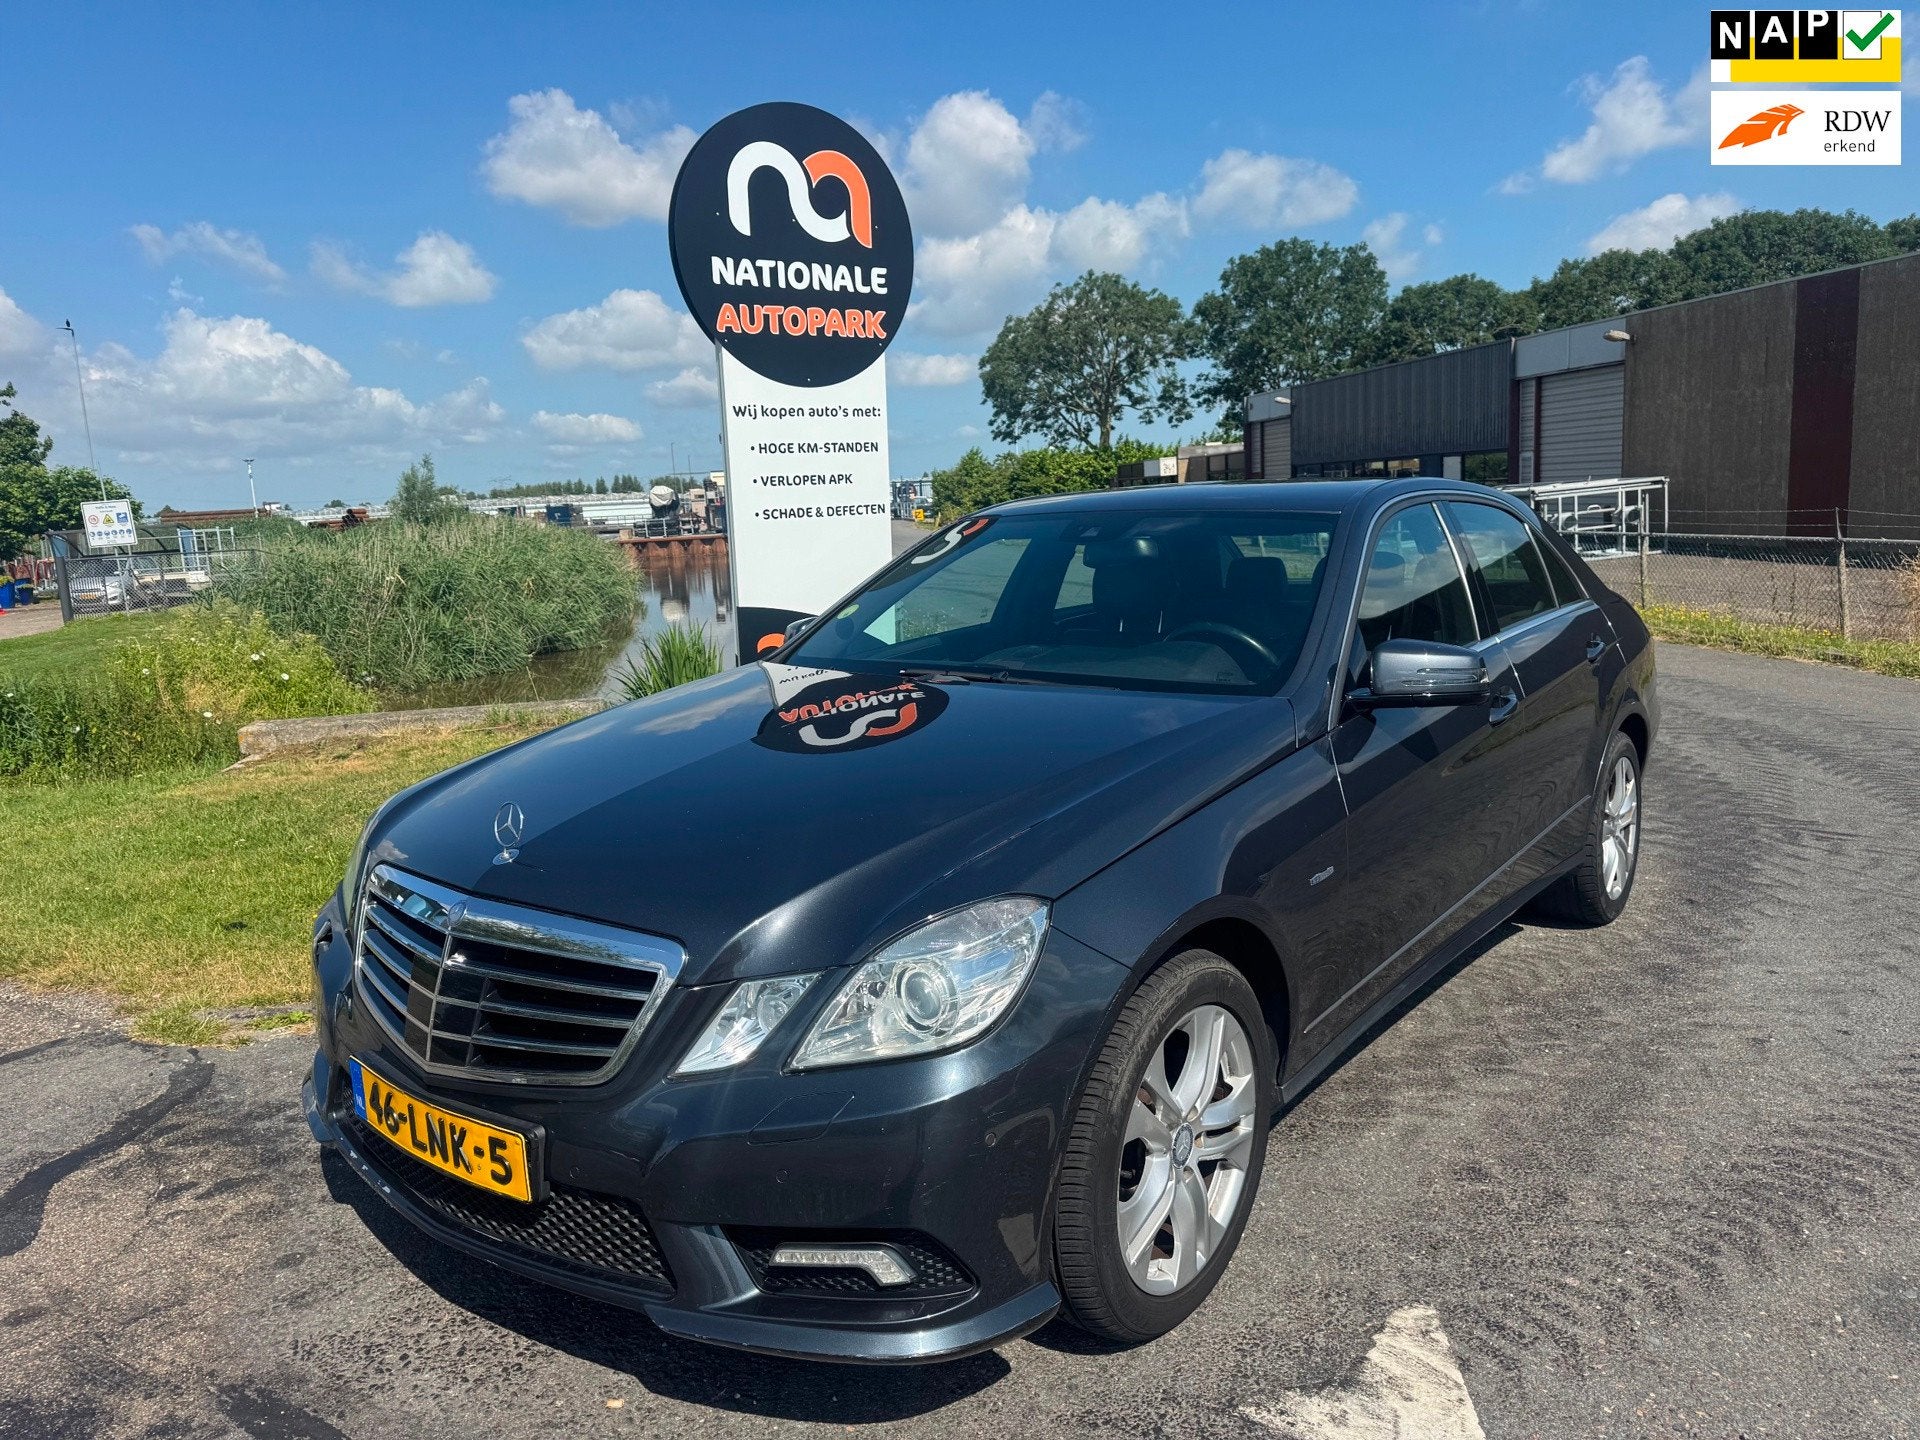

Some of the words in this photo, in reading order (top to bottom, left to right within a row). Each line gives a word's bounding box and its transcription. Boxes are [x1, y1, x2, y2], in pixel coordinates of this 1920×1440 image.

[711, 255, 888, 295] NATIONALE
[716, 302, 887, 339] AUTOPARK
[733, 405, 758, 420] Wij
[761, 405, 804, 420] kopen
[808, 405, 849, 417] auto's
[852, 406, 881, 417] met:
[759, 443, 795, 454] HOGE
[798, 442, 879, 454] KM-STANDEN
[761, 474, 826, 487] VERLOPEN
[829, 474, 853, 485] APK
[763, 507, 813, 520] SCHADE
[816, 507, 824, 518] &
[827, 504, 886, 517] DEFECTEN
[369, 1082, 513, 1185] 46-LNK-5
